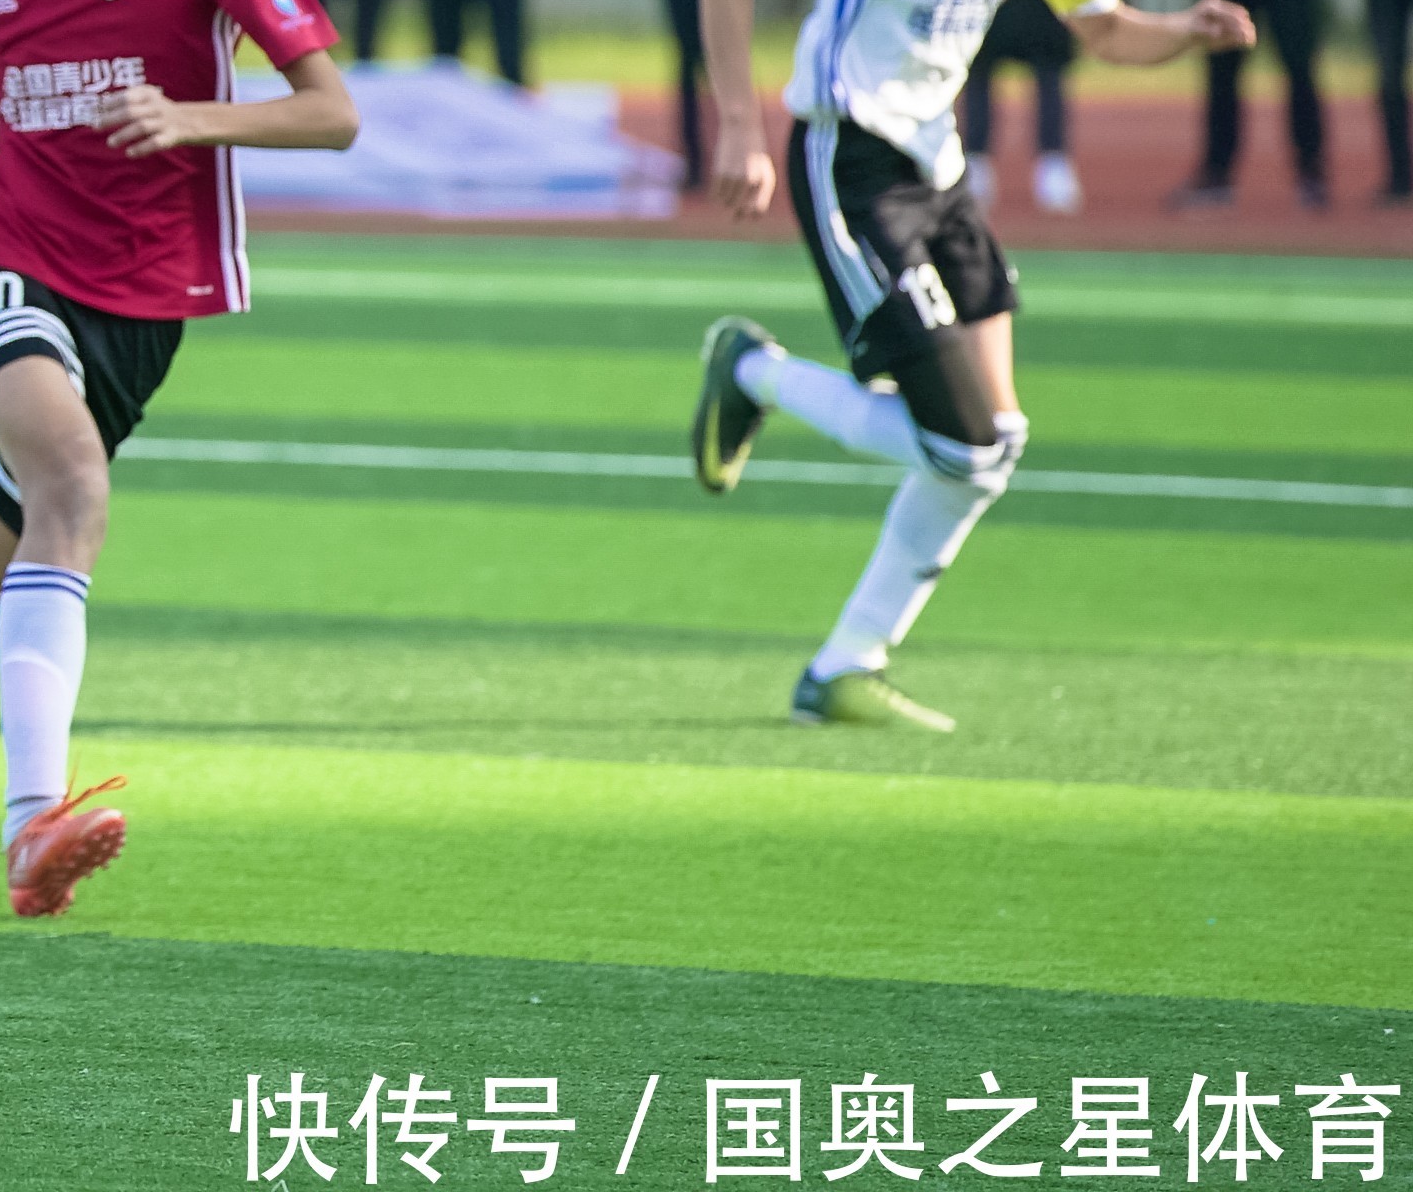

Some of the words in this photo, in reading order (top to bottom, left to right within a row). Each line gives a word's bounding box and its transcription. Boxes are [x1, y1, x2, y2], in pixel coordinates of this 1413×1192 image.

[3, 57, 147, 98] 全国青少年
[897, 263, 957, 330] 13
